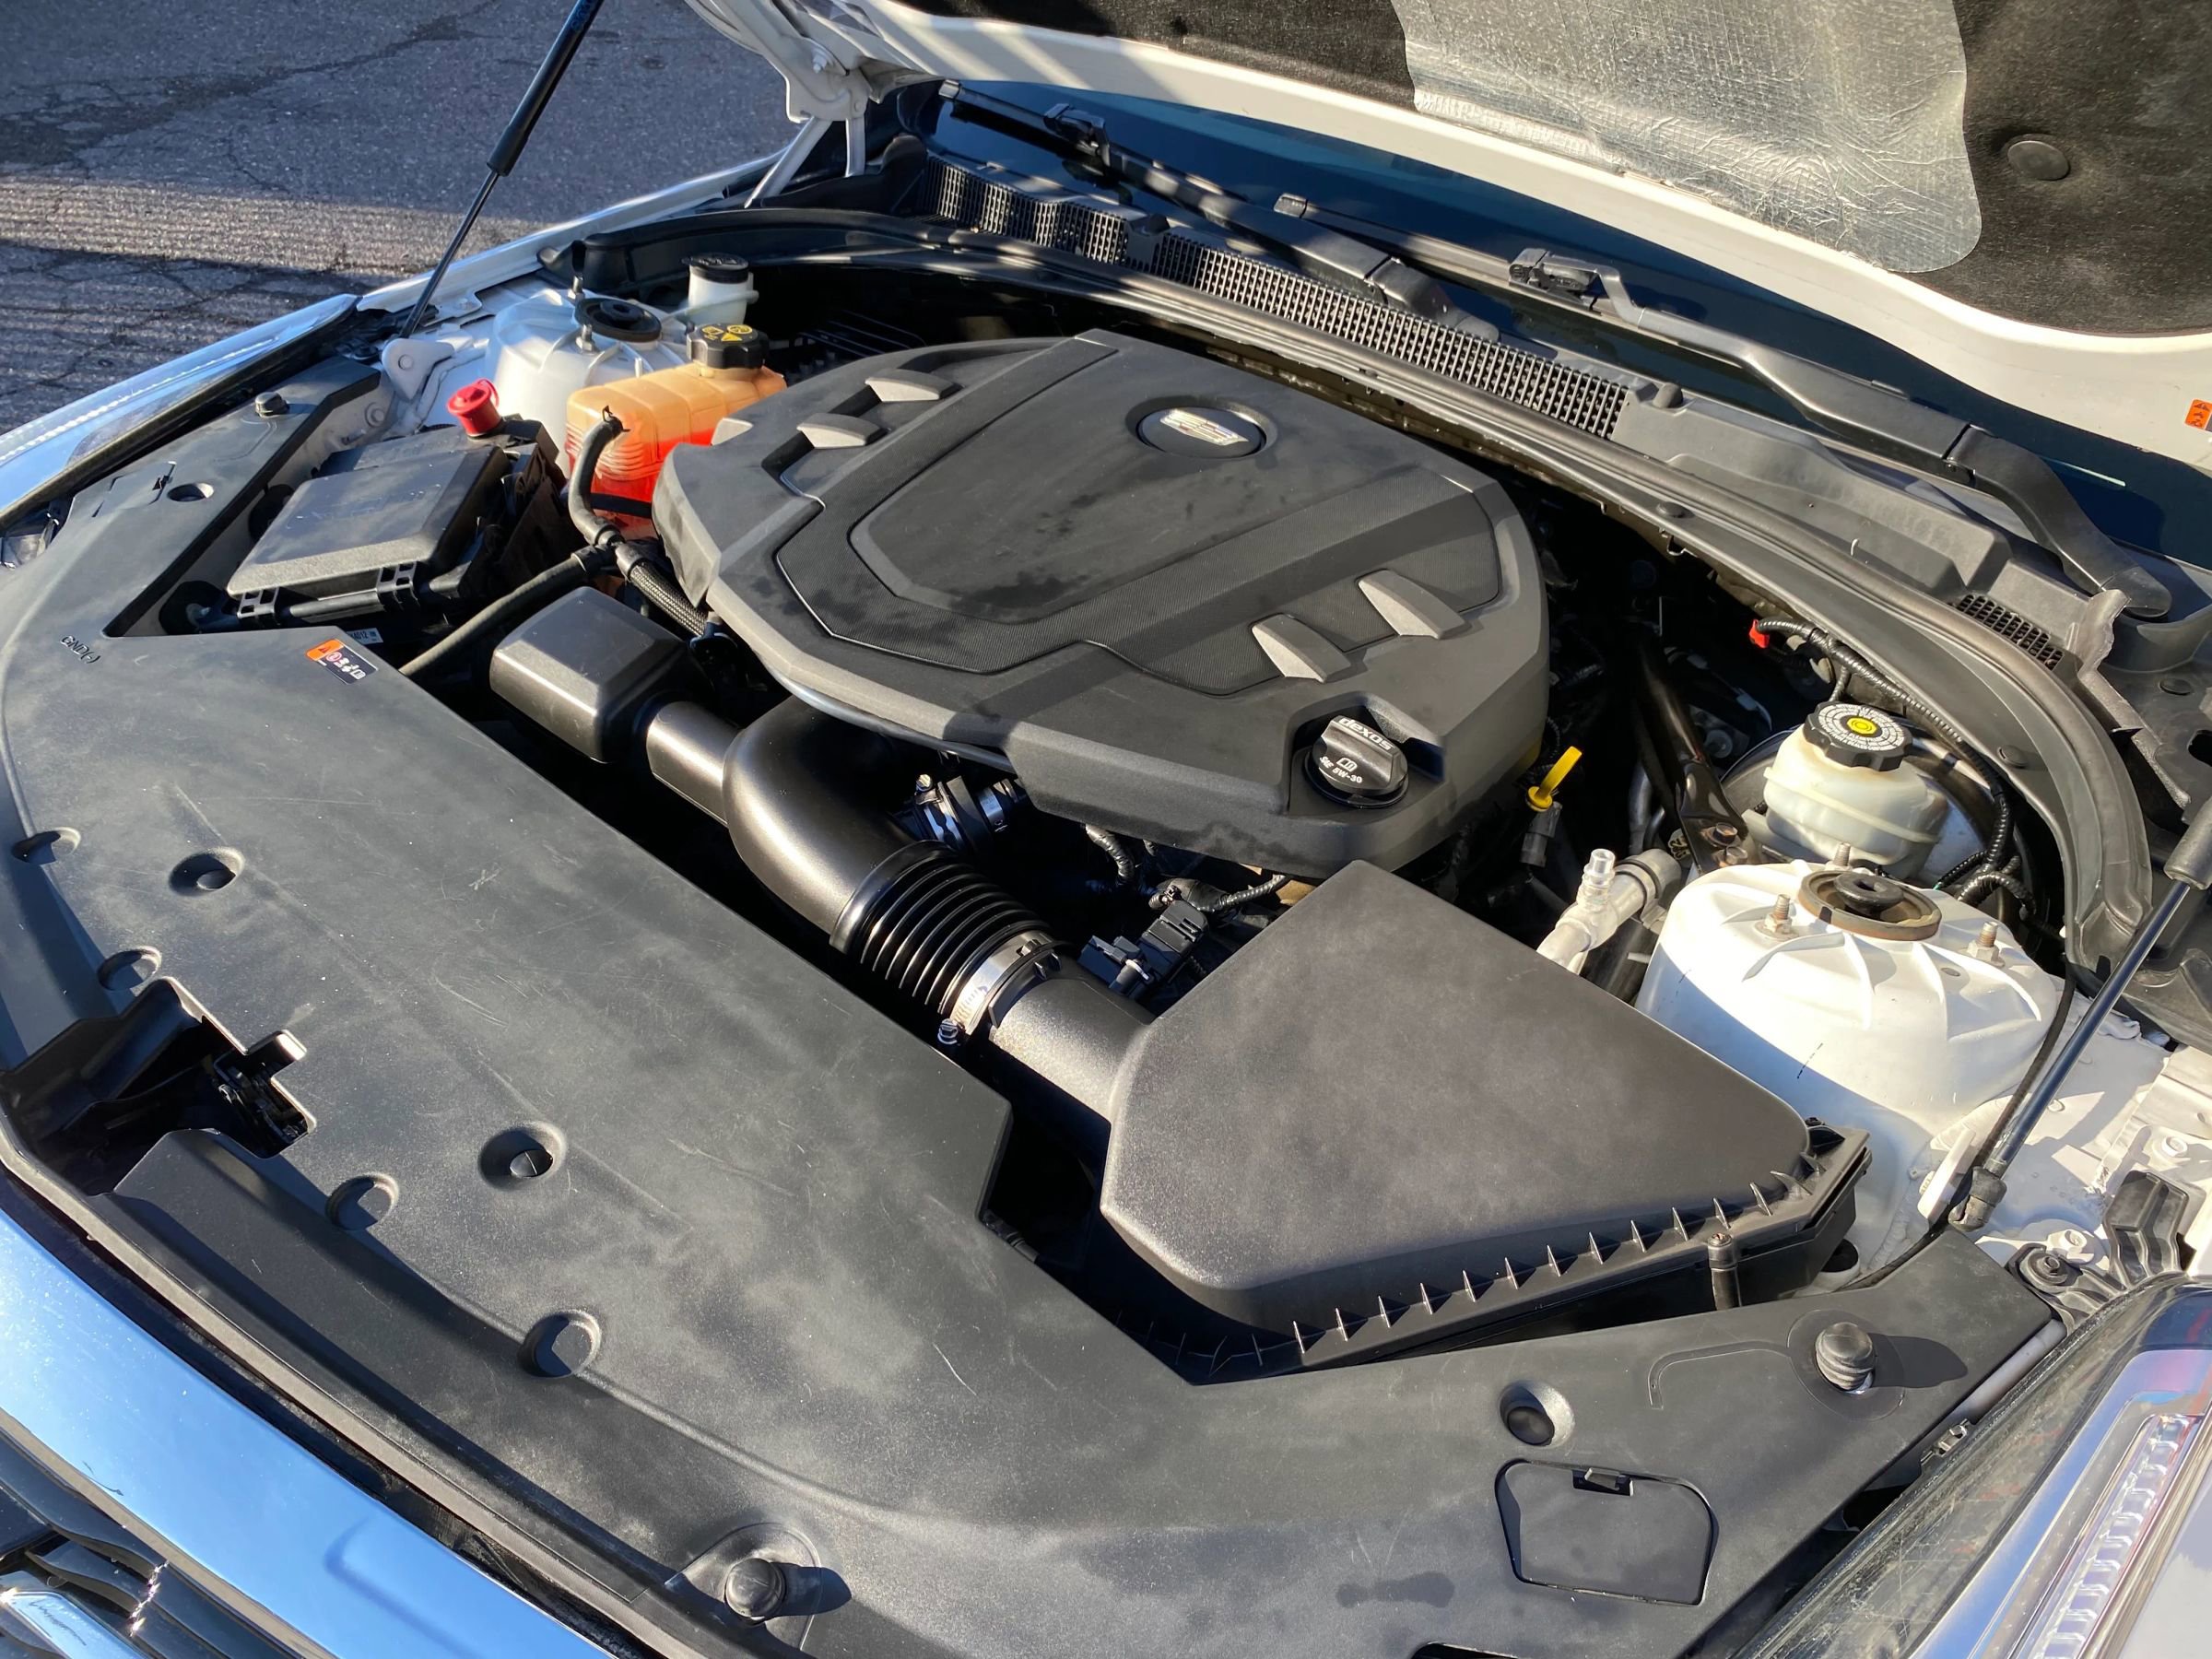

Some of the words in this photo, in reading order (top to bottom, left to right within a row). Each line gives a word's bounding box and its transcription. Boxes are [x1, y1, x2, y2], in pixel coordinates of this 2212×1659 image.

[1338, 718, 1393, 750] dexos
[1319, 756, 1335, 769] SAE
[1332, 767, 1363, 783] 5W-30
